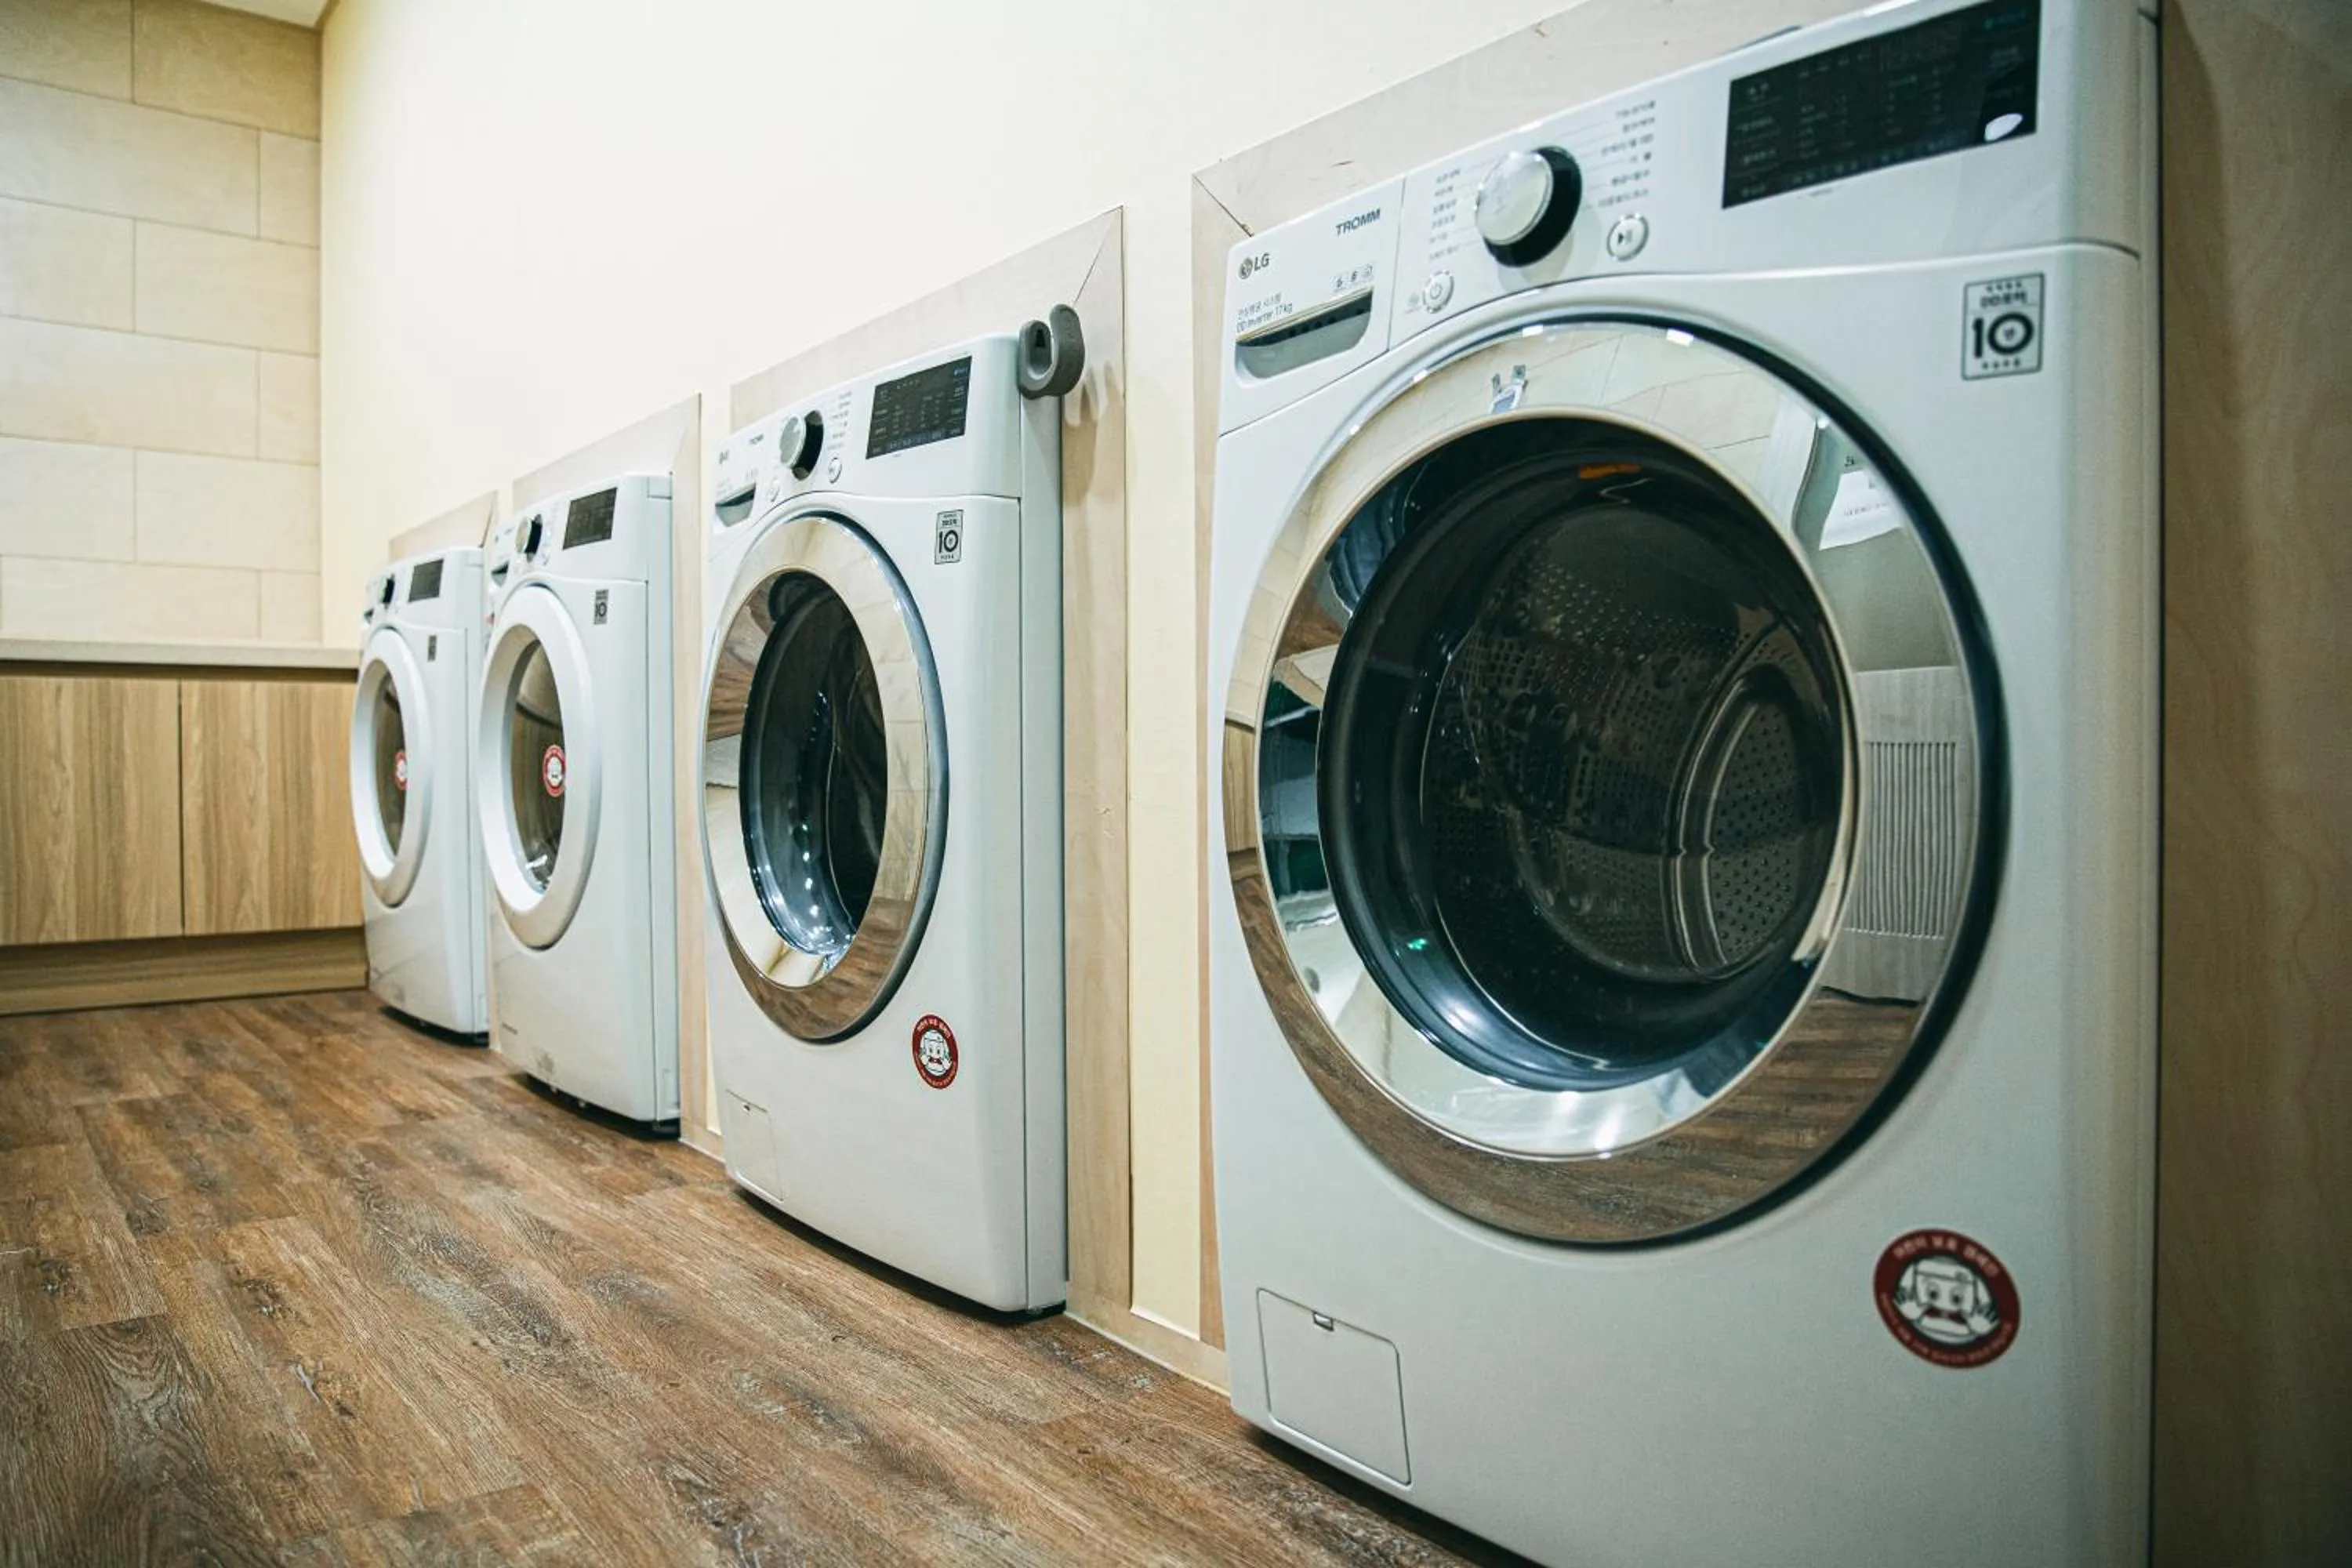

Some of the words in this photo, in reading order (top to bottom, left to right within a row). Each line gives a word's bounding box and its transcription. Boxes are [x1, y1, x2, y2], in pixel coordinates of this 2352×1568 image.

[1335, 208, 1381, 236] TROMM
[1254, 252, 1270, 271] LG
[1972, 311, 2034, 360] 10
[938, 529, 959, 554] 10
